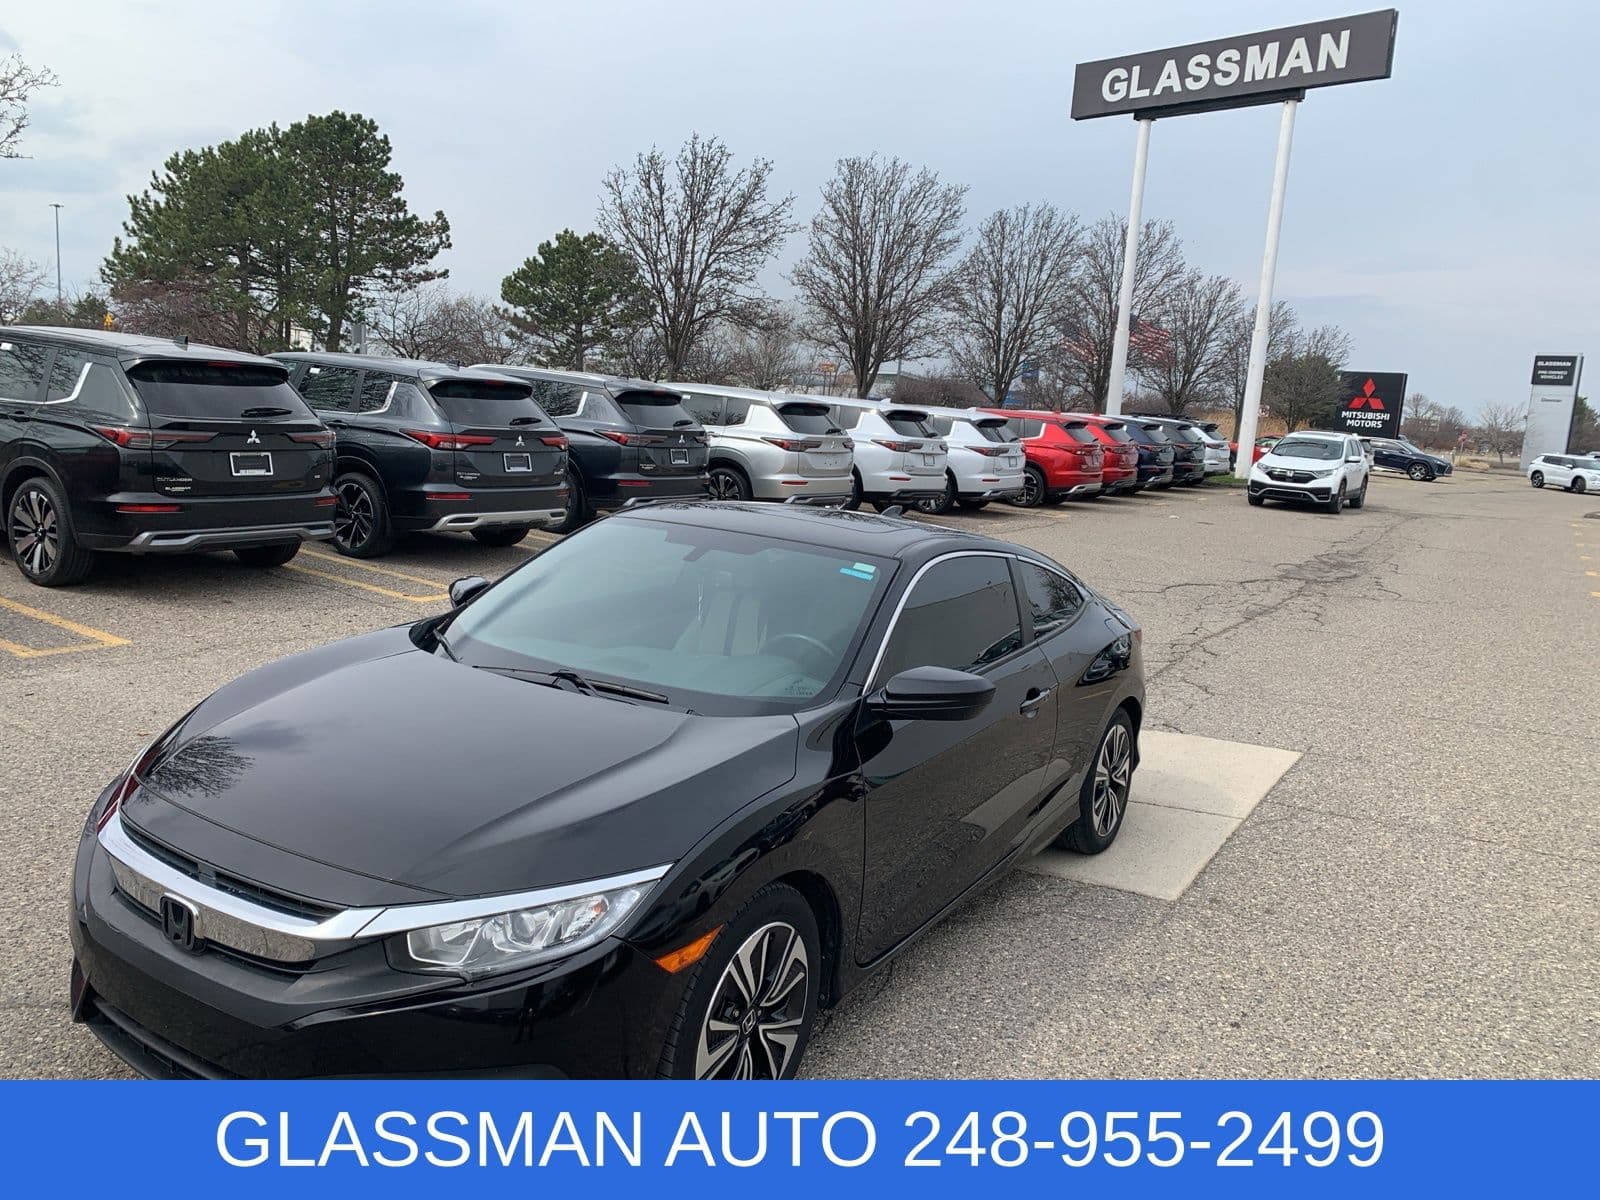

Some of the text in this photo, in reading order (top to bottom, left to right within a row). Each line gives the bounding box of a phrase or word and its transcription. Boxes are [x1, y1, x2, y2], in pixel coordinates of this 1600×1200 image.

[1101, 29, 1350, 103] GLASSMAN
[1341, 411, 1390, 420] MITSUBISHI
[1346, 419, 1383, 428] MOTORS
